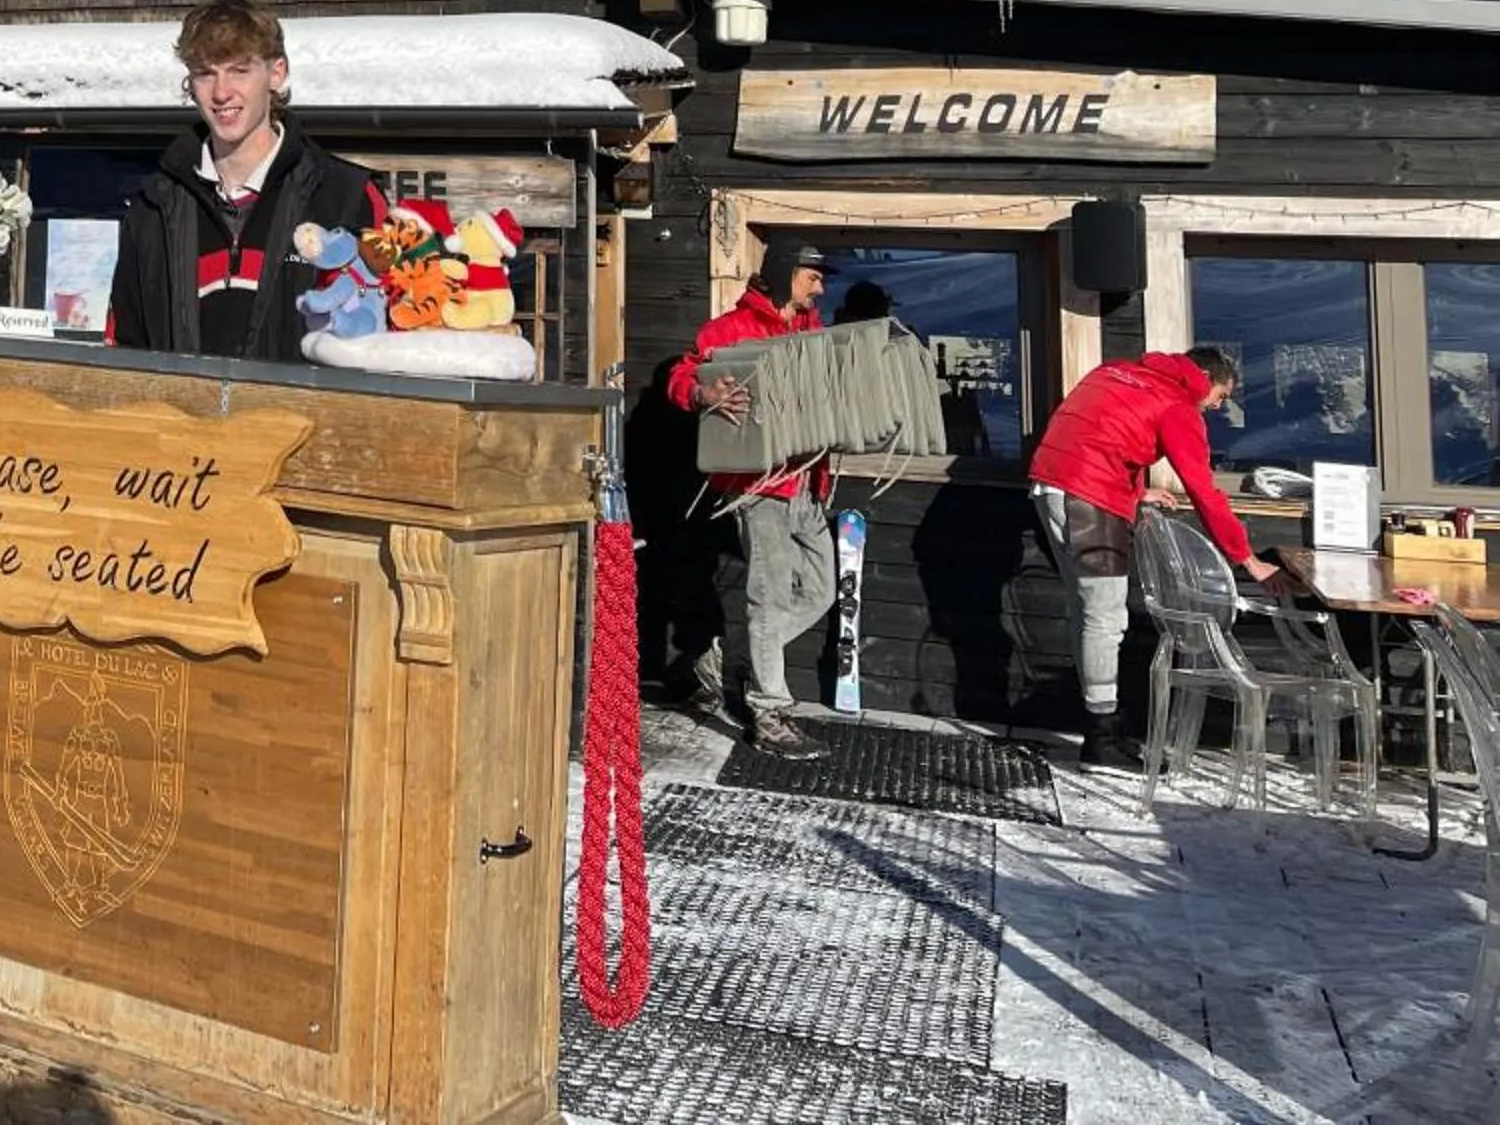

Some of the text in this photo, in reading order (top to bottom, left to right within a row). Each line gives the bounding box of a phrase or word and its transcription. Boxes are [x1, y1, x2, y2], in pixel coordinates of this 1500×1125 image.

[819, 93, 1109, 134] WELCOME
[116, 456, 220, 510] wait
[47, 539, 210, 603] seated
[41, 643, 157, 679] HOTEL DU LAC
